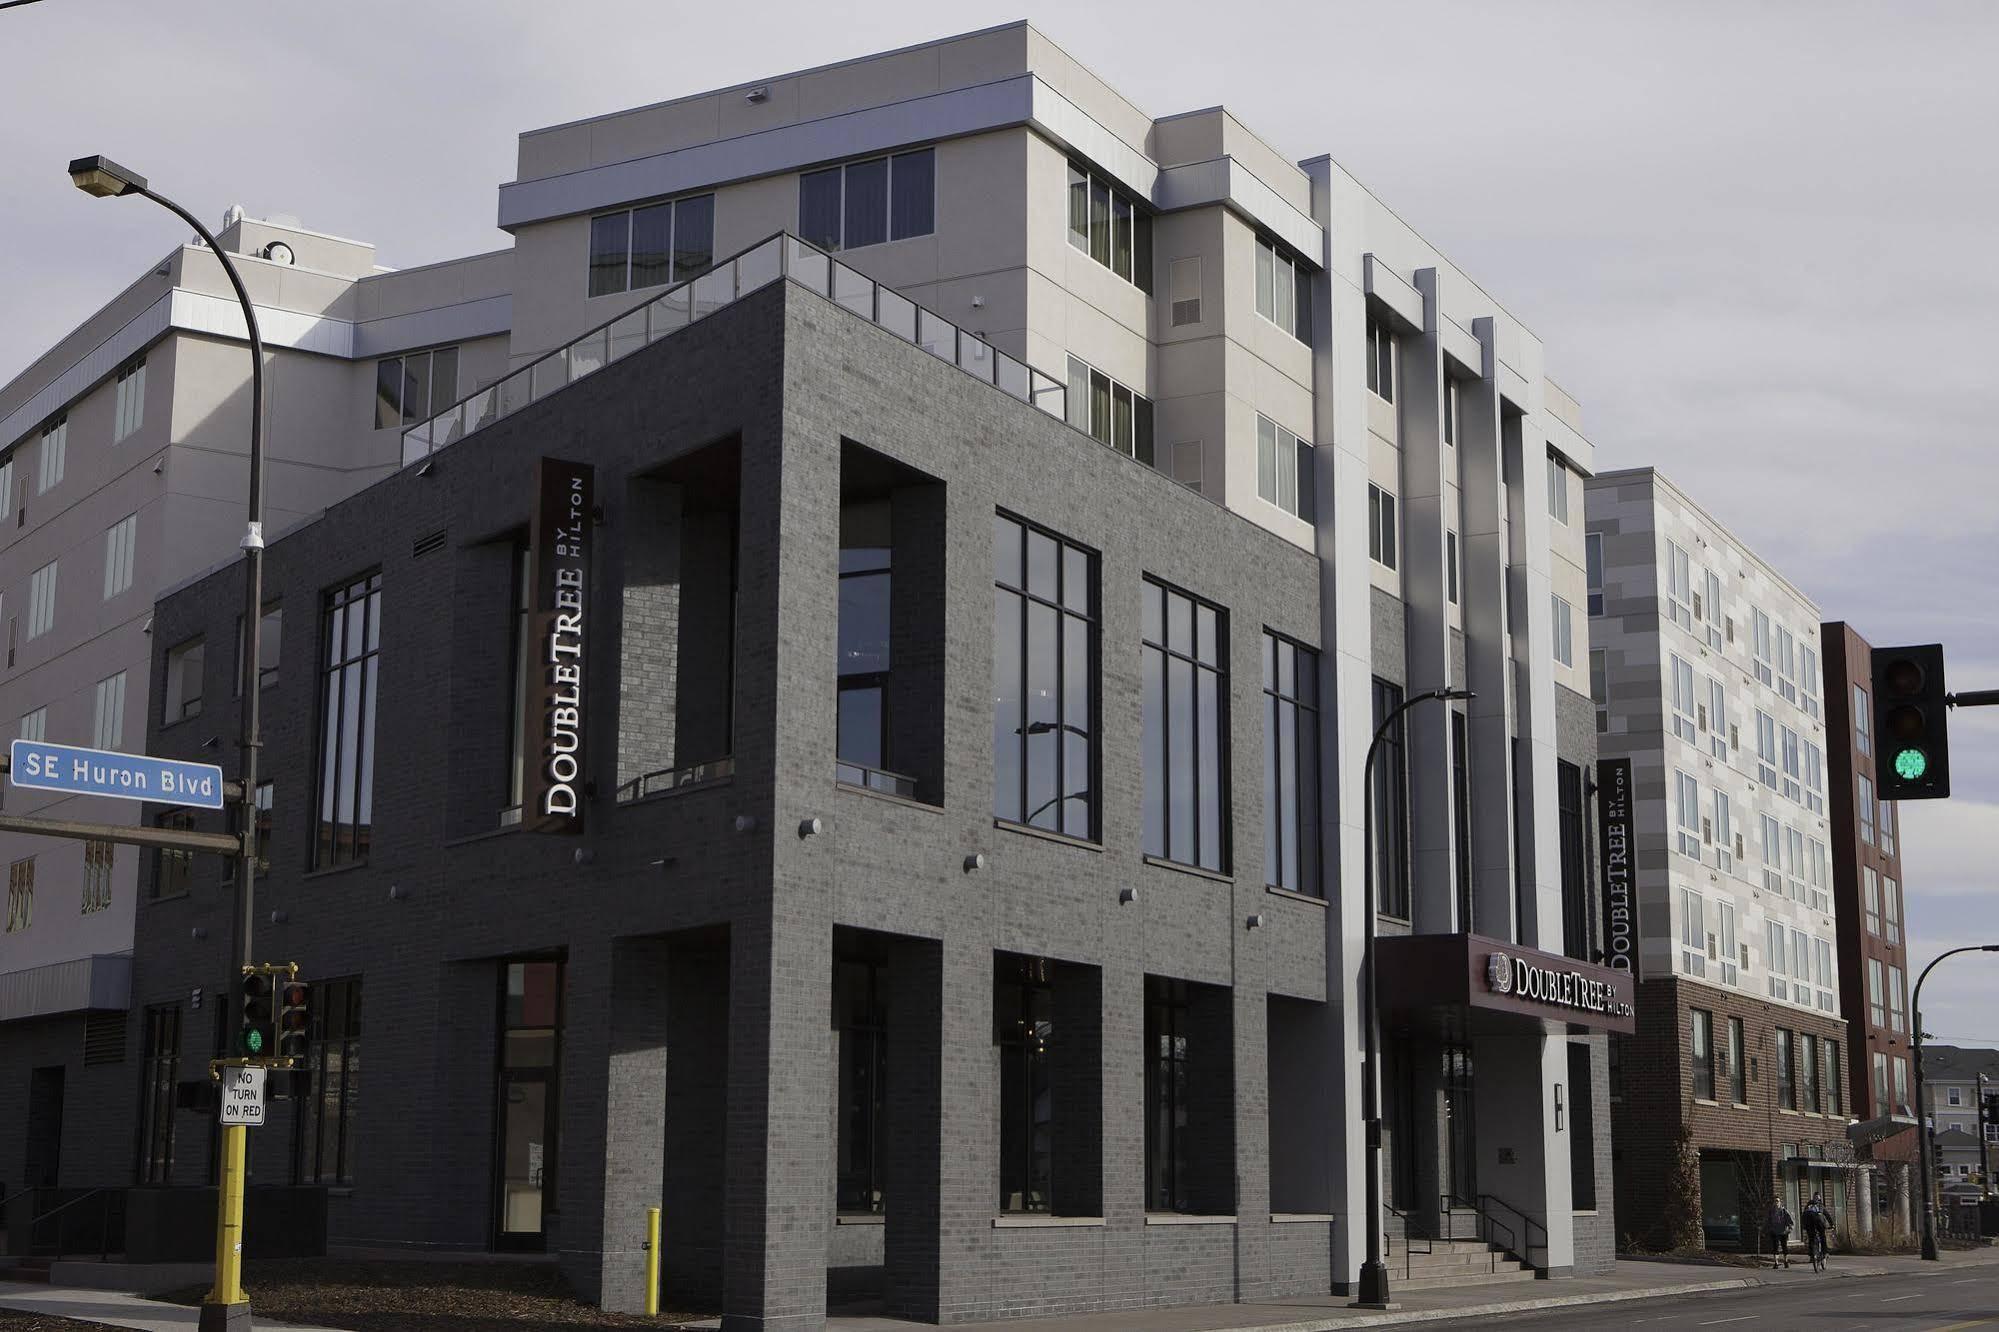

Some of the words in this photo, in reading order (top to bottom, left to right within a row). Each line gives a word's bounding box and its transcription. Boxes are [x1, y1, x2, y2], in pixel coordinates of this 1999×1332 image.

[570, 477, 583, 558] HILTON
[556, 527, 568, 556] BY
[25, 752, 59, 779] SE
[73, 759, 147, 789] Huron
[161, 770, 213, 797] Blvd
[1616, 767, 1625, 817] HILTON
[1609, 800, 1617, 818] BY
[1607, 984, 1617, 998] BY
[1607, 1001, 1634, 1017] HILTON
[238, 1072, 253, 1084] NO
[232, 1089, 257, 1100] TURN
[226, 1105, 238, 1116] ON
[243, 1105, 261, 1117] RED
